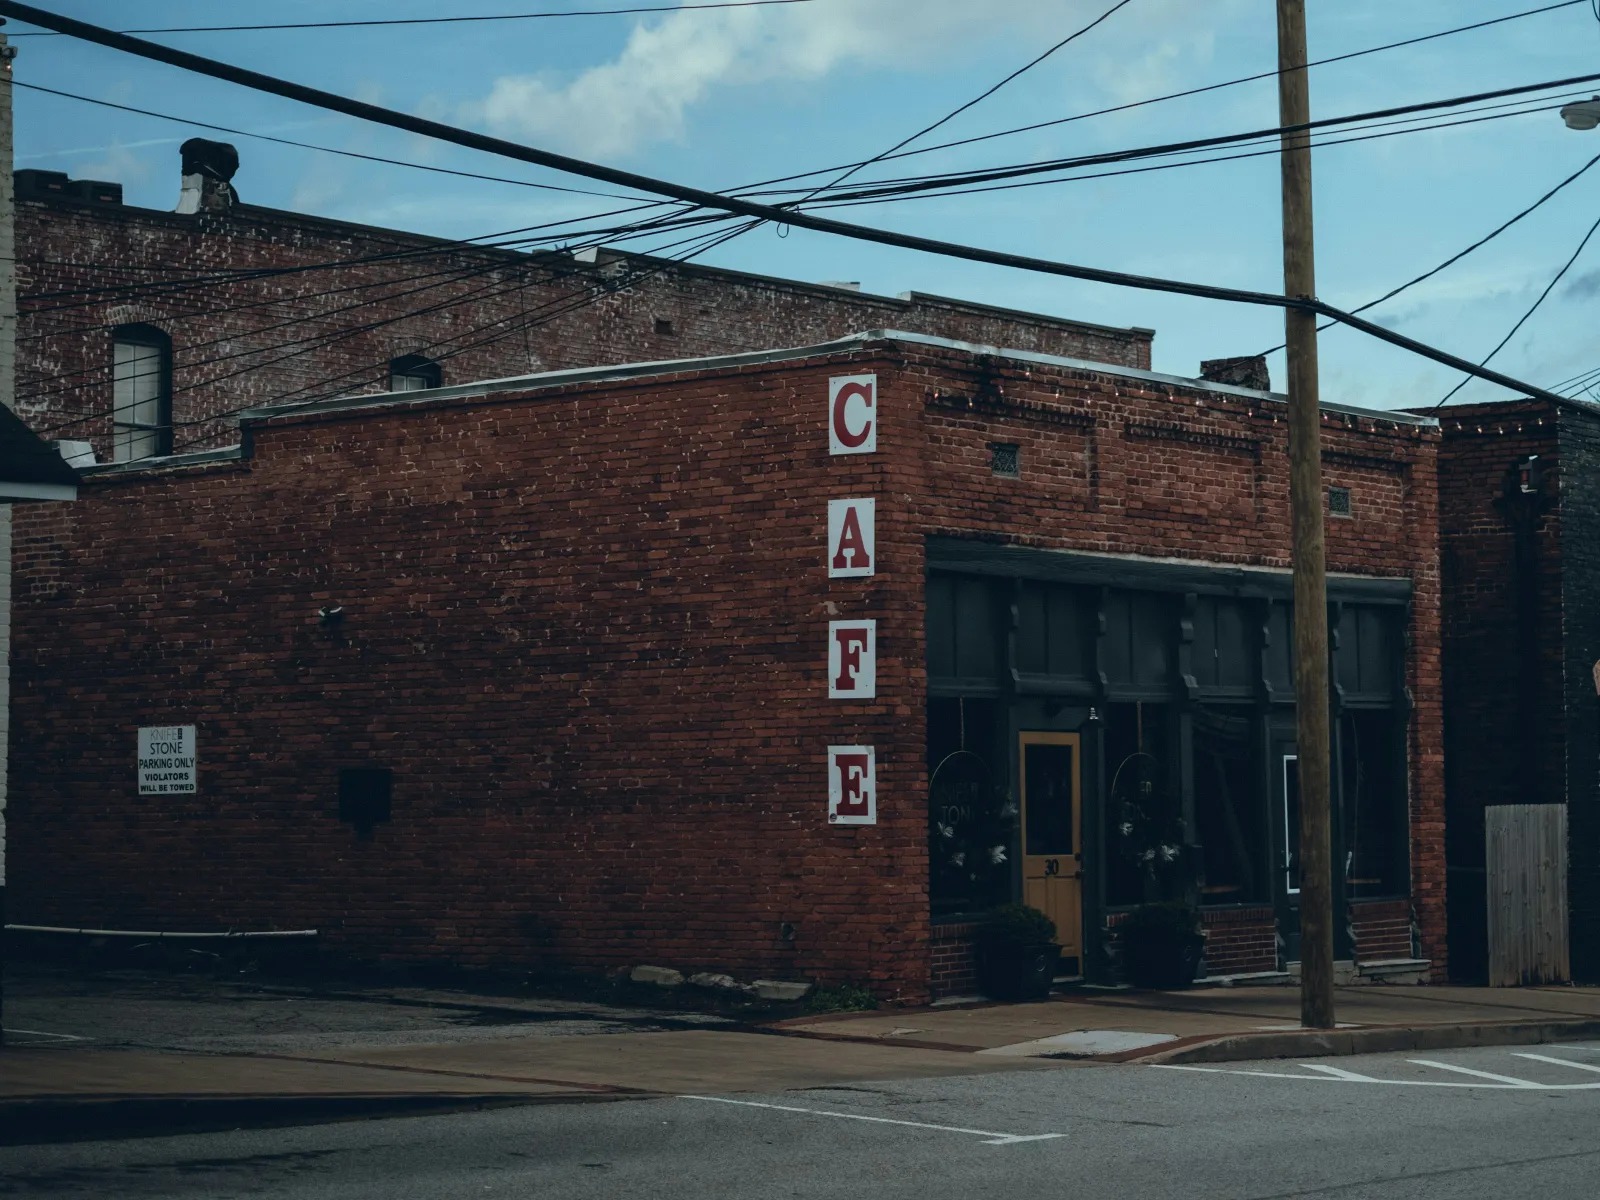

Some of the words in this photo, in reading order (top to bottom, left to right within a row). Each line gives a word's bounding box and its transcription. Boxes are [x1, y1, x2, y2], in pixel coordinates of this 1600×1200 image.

[832, 382, 874, 816] CAFE
[150, 728, 178, 741] KNIFE
[150, 742, 183, 755] STONE
[139, 758, 172, 769] PARKING
[174, 758, 194, 768] ONLY
[145, 773, 189, 781] VIOLATORS
[1045, 859, 1059, 875] 30
